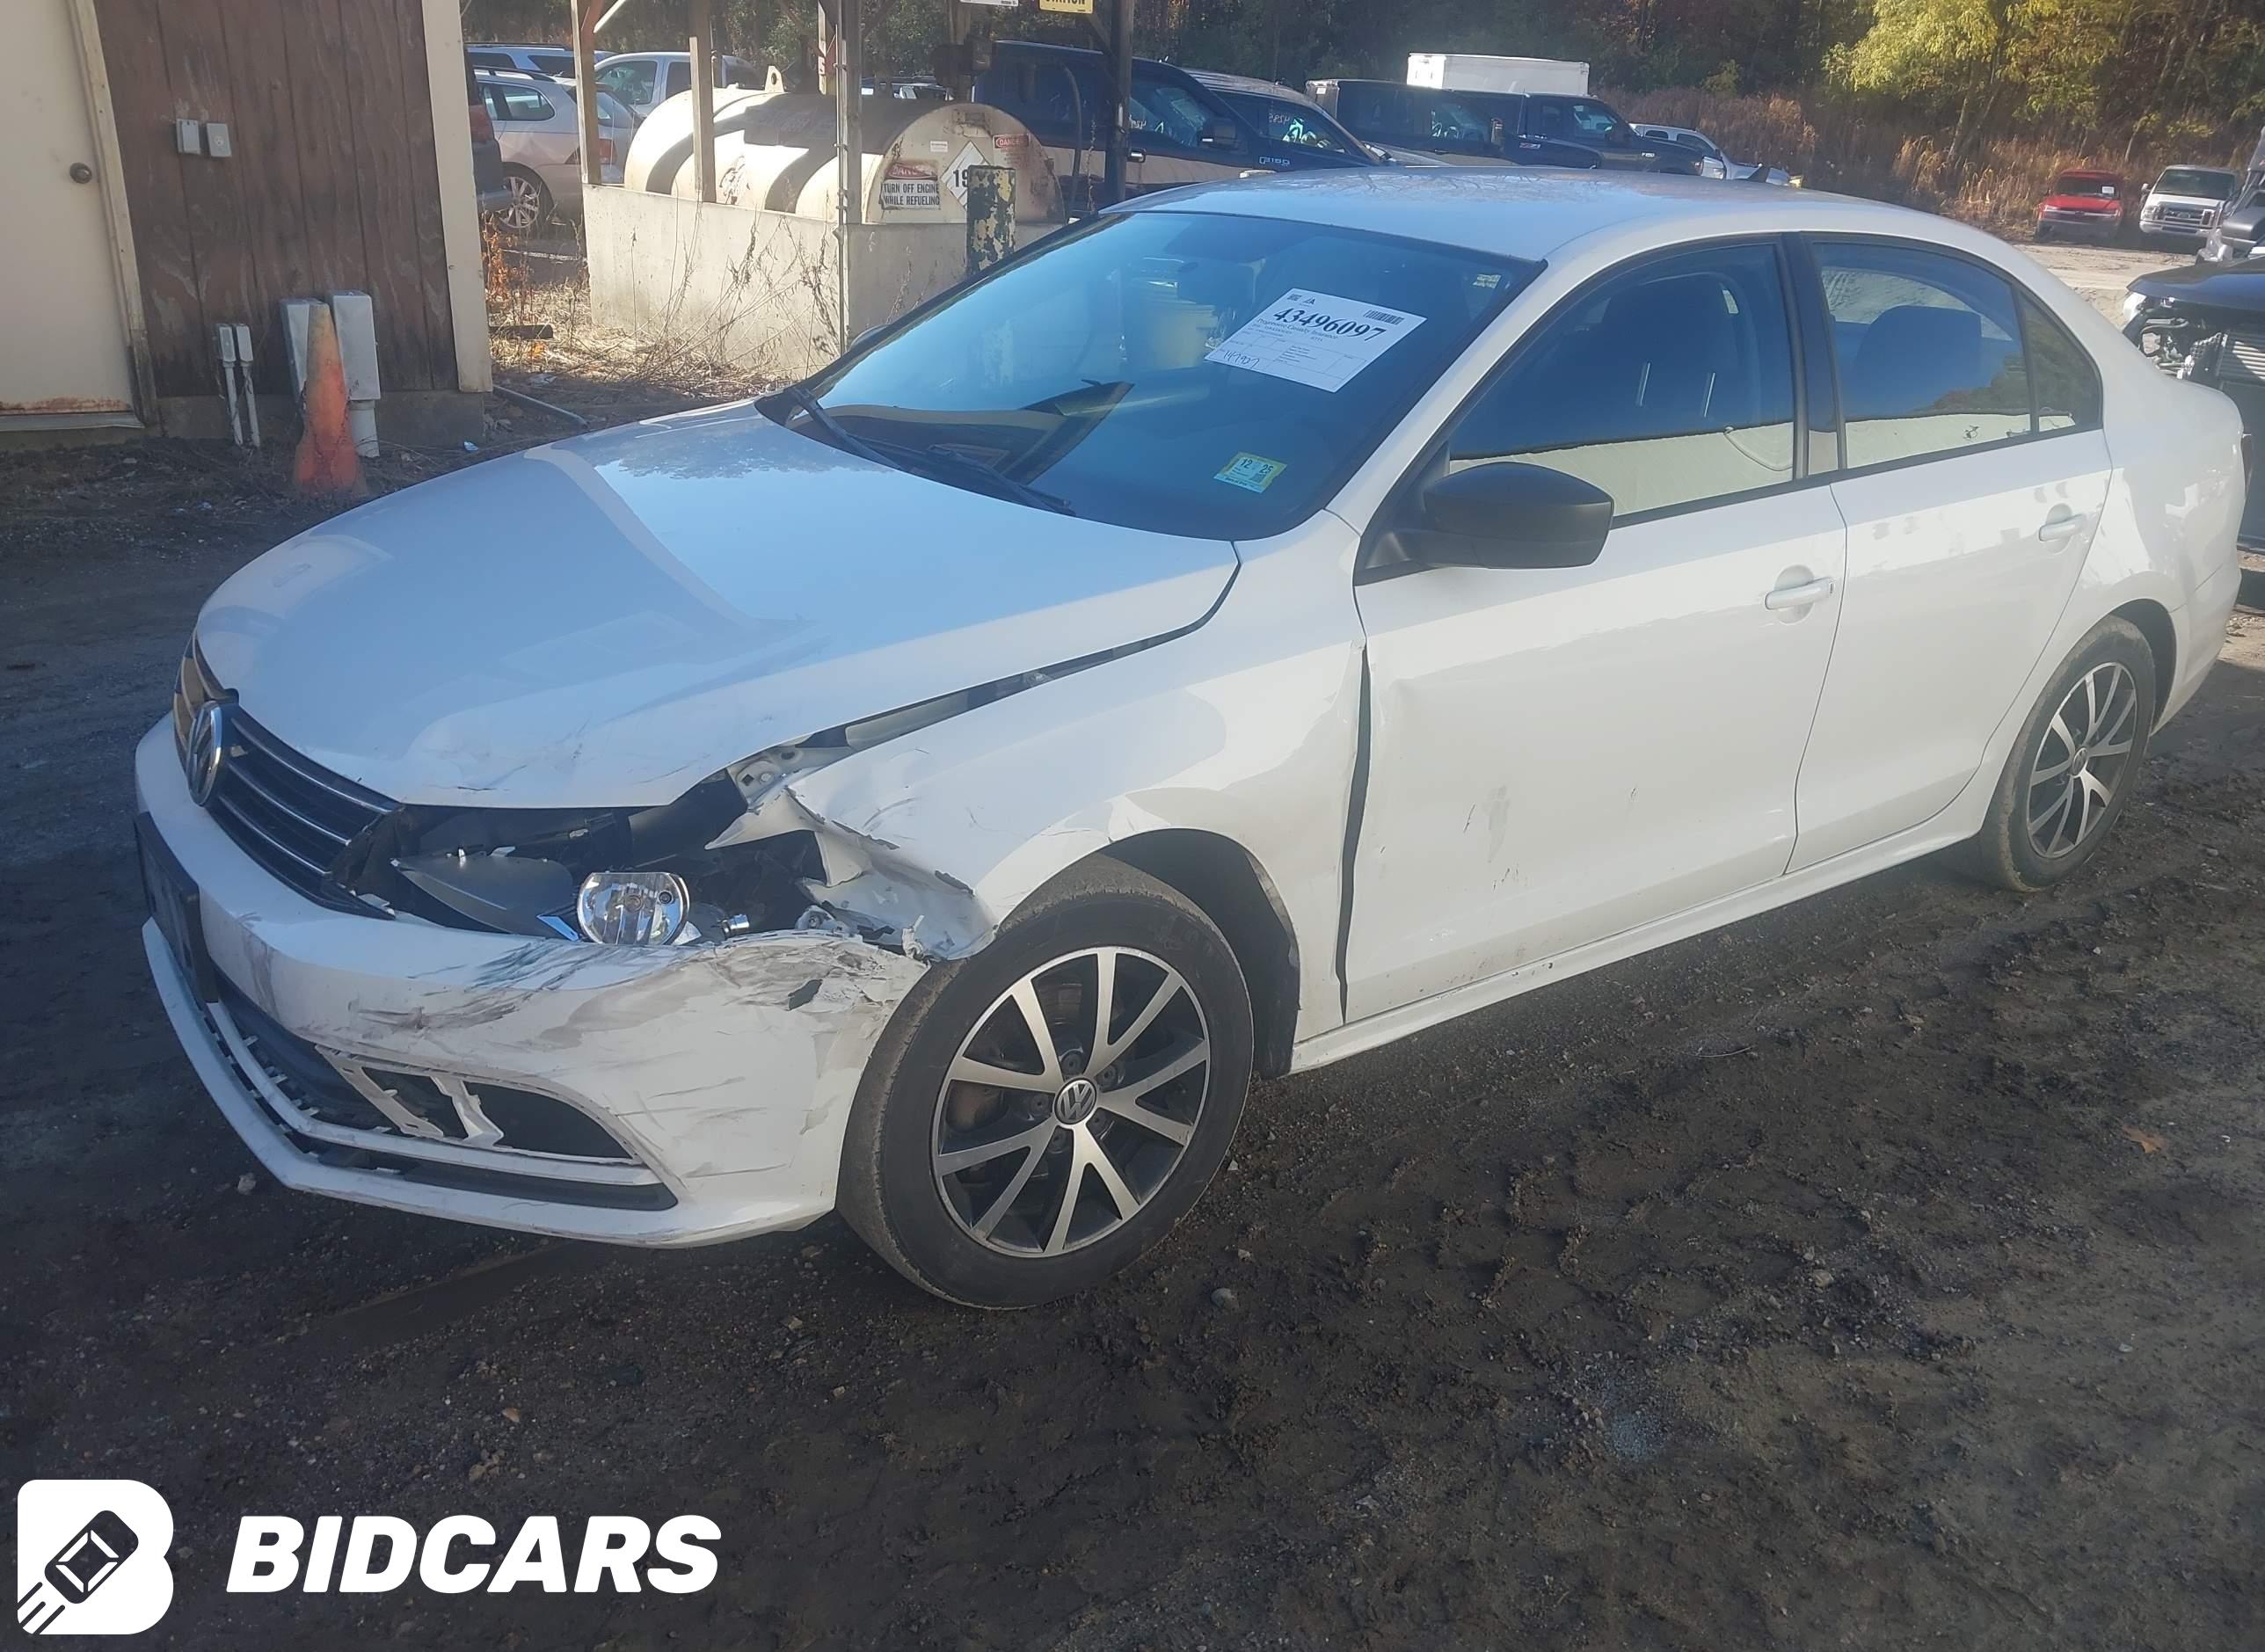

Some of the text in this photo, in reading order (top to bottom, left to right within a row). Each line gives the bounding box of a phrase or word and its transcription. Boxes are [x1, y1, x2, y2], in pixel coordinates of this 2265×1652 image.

[885, 183, 939, 193] TURN OFF ENGINE
[885, 195, 940, 206] WHILE REFUELING
[1273, 308, 1387, 342] 43496097
[1240, 459, 1253, 469] 12
[1259, 464, 1274, 474] 25
